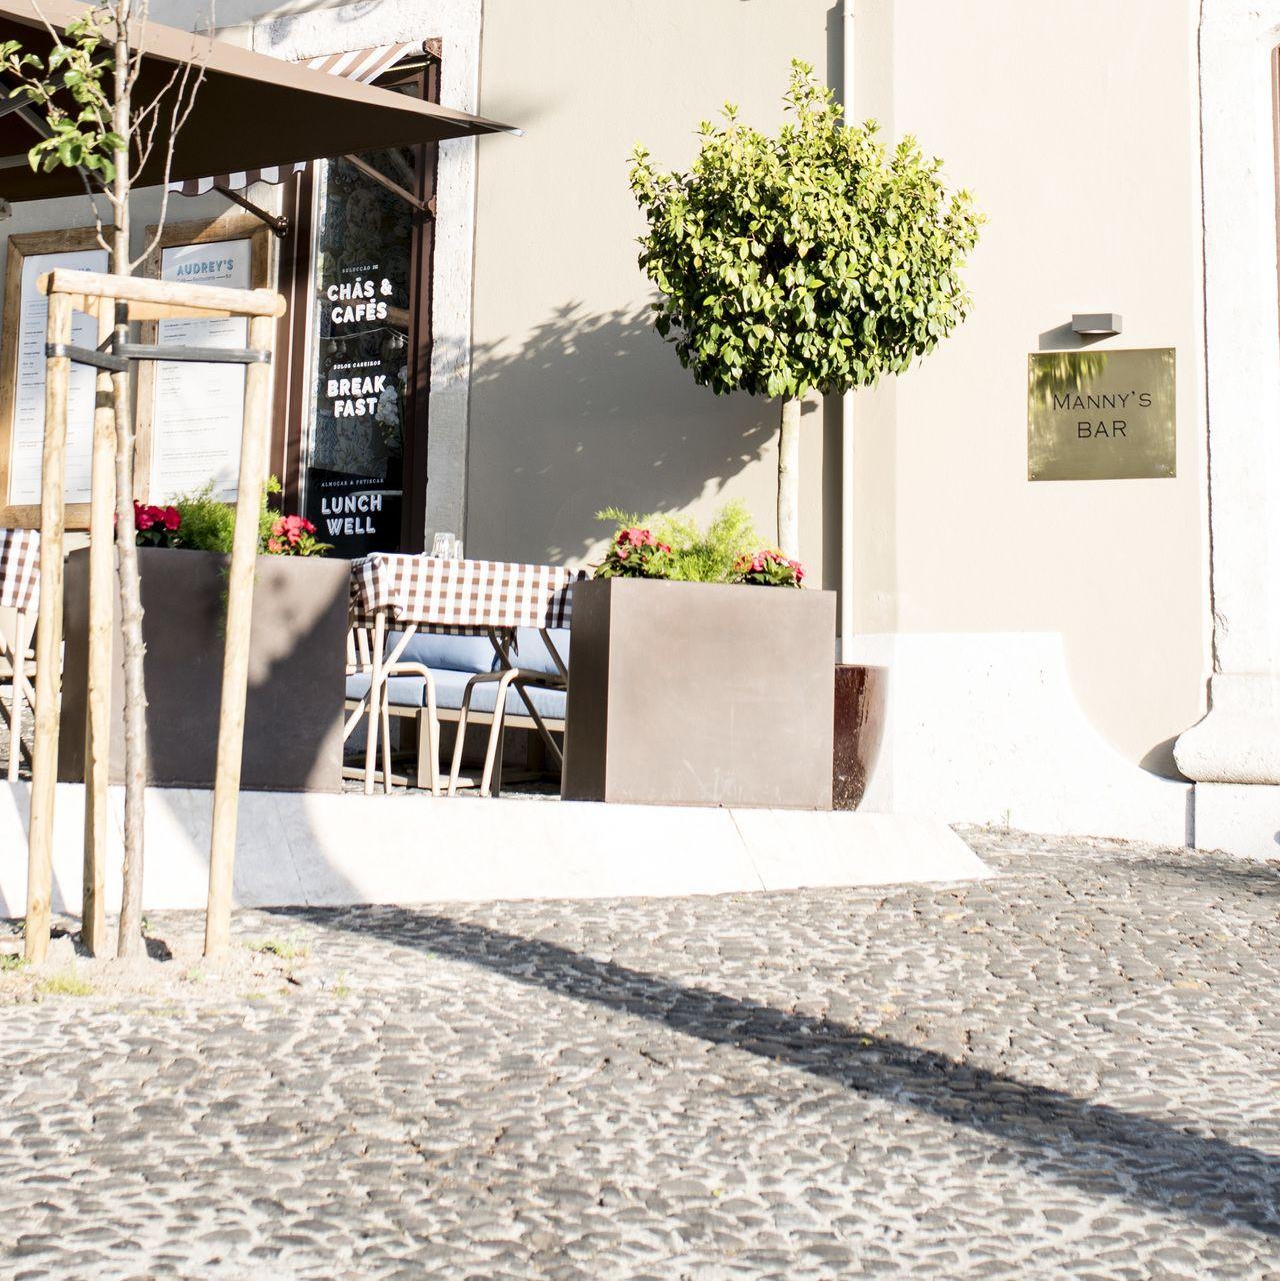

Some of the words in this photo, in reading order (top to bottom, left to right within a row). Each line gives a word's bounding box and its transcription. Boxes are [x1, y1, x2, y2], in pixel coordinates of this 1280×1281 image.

[177, 259, 234, 276] AUDREY'S
[327, 277, 375, 302] CHÁS
[380, 278, 393, 296] &
[331, 298, 388, 324] CAFÉS
[327, 374, 387, 397] BREAK
[334, 397, 378, 418] FAST
[1053, 390, 1152, 411] MANNY'S
[1077, 420, 1128, 439] BAR
[321, 494, 383, 515] LUNCH
[326, 516, 376, 536] WELL
